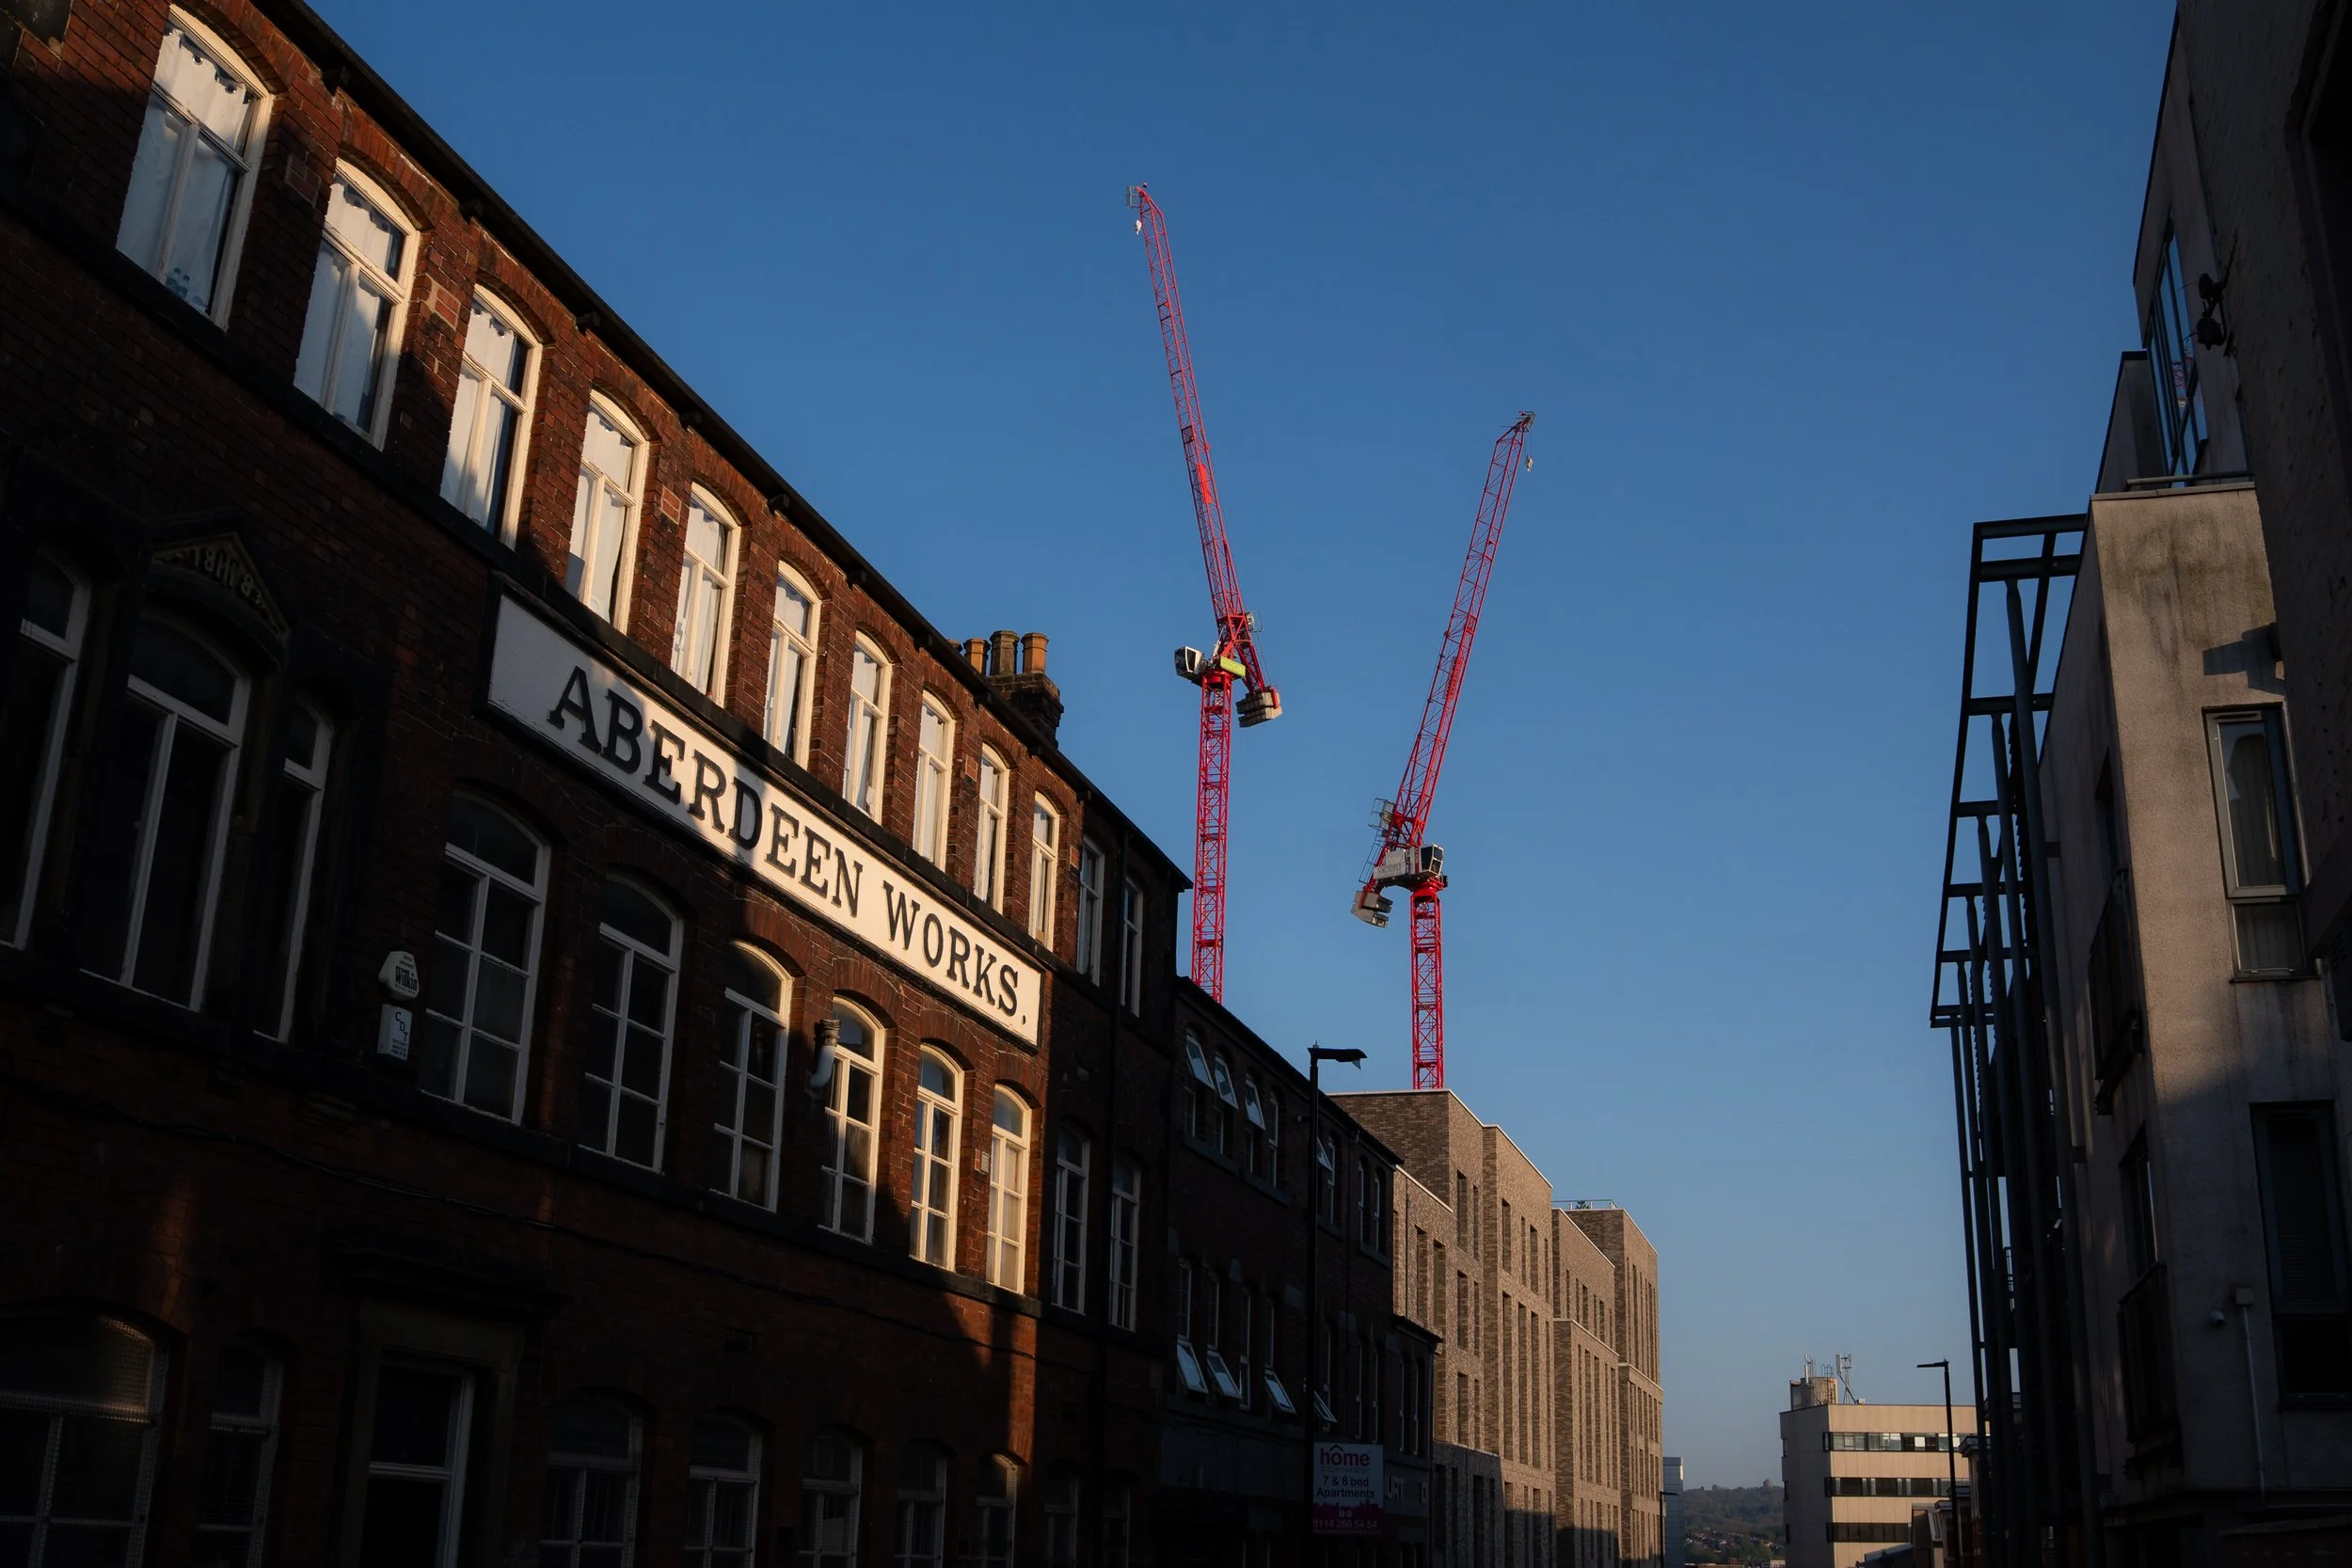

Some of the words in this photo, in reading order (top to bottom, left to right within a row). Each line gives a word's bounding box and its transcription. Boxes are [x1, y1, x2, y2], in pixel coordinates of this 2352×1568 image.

[547, 665, 863, 918] ABERDEEN
[882, 879, 1027, 1025] WORKS.
[395, 965, 418, 991] Wilkin
[1320, 1445, 1371, 1467] home
[1323, 1475, 1329, 1485] 7
[1331, 1475, 1340, 1486] &
[1342, 1476, 1348, 1486] 8
[1350, 1477, 1369, 1487] bed
[1316, 1487, 1375, 1499] Apartments
[1312, 1518, 1334, 1528] 0114
